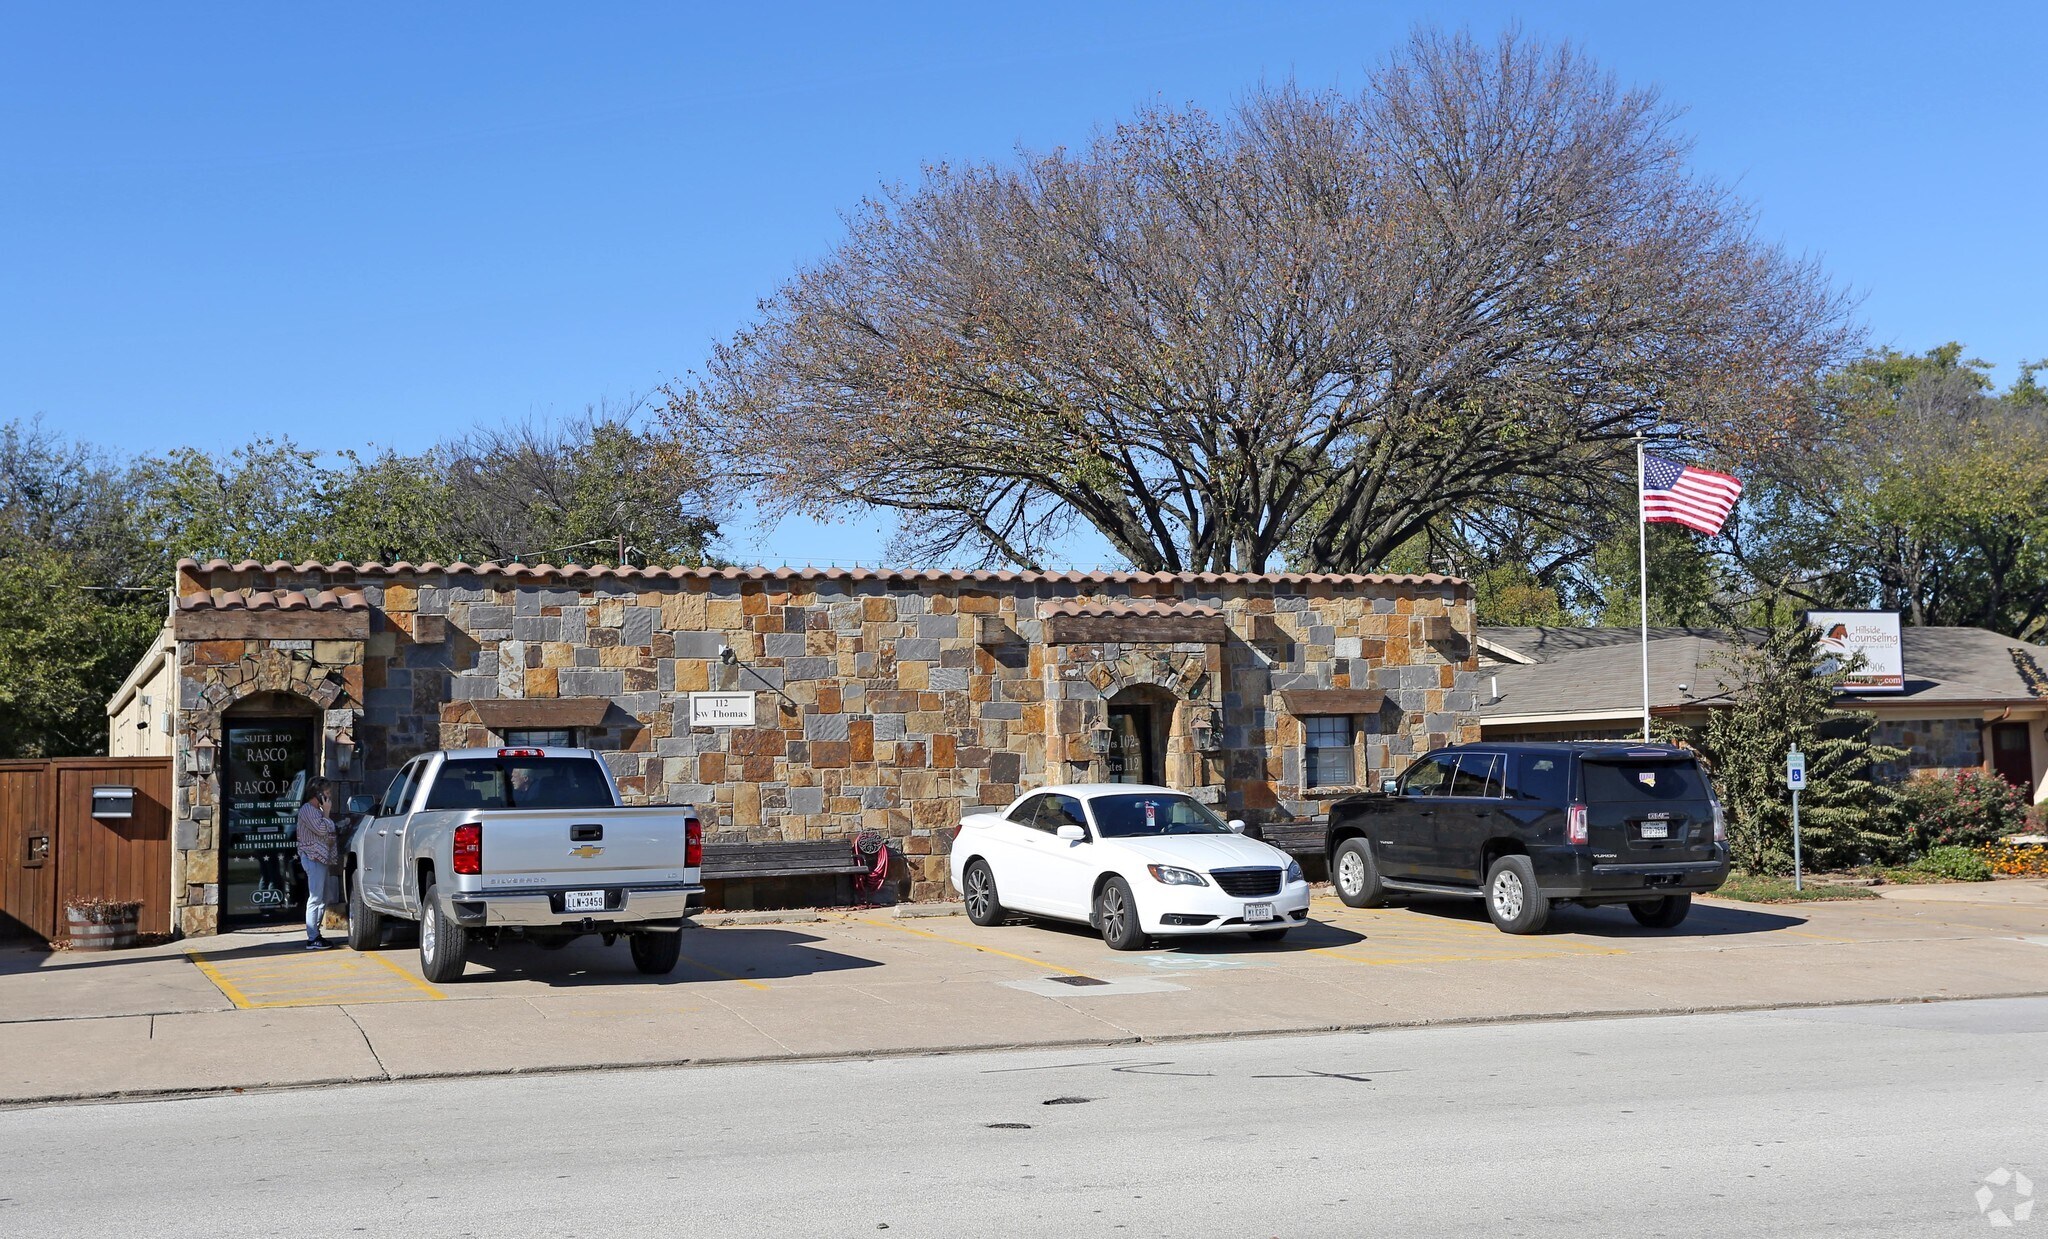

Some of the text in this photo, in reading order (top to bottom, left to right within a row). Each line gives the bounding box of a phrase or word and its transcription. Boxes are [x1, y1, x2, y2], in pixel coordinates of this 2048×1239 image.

[1855, 625, 1881, 634] Hillside
[1849, 632, 1898, 645] Counseling
[715, 699, 729, 707] 112
[712, 709, 748, 718] Thomas
[244, 734, 292, 743] SUITE 100
[247, 747, 288, 762] RASCO
[1124, 757, 1139, 771] 112
[262, 764, 271, 778] &
[234, 780, 278, 795] RASCO,
[1647, 812, 1669, 820] GMC
[490, 877, 547, 885] SILVERADO
[252, 891, 281, 903] CPA
